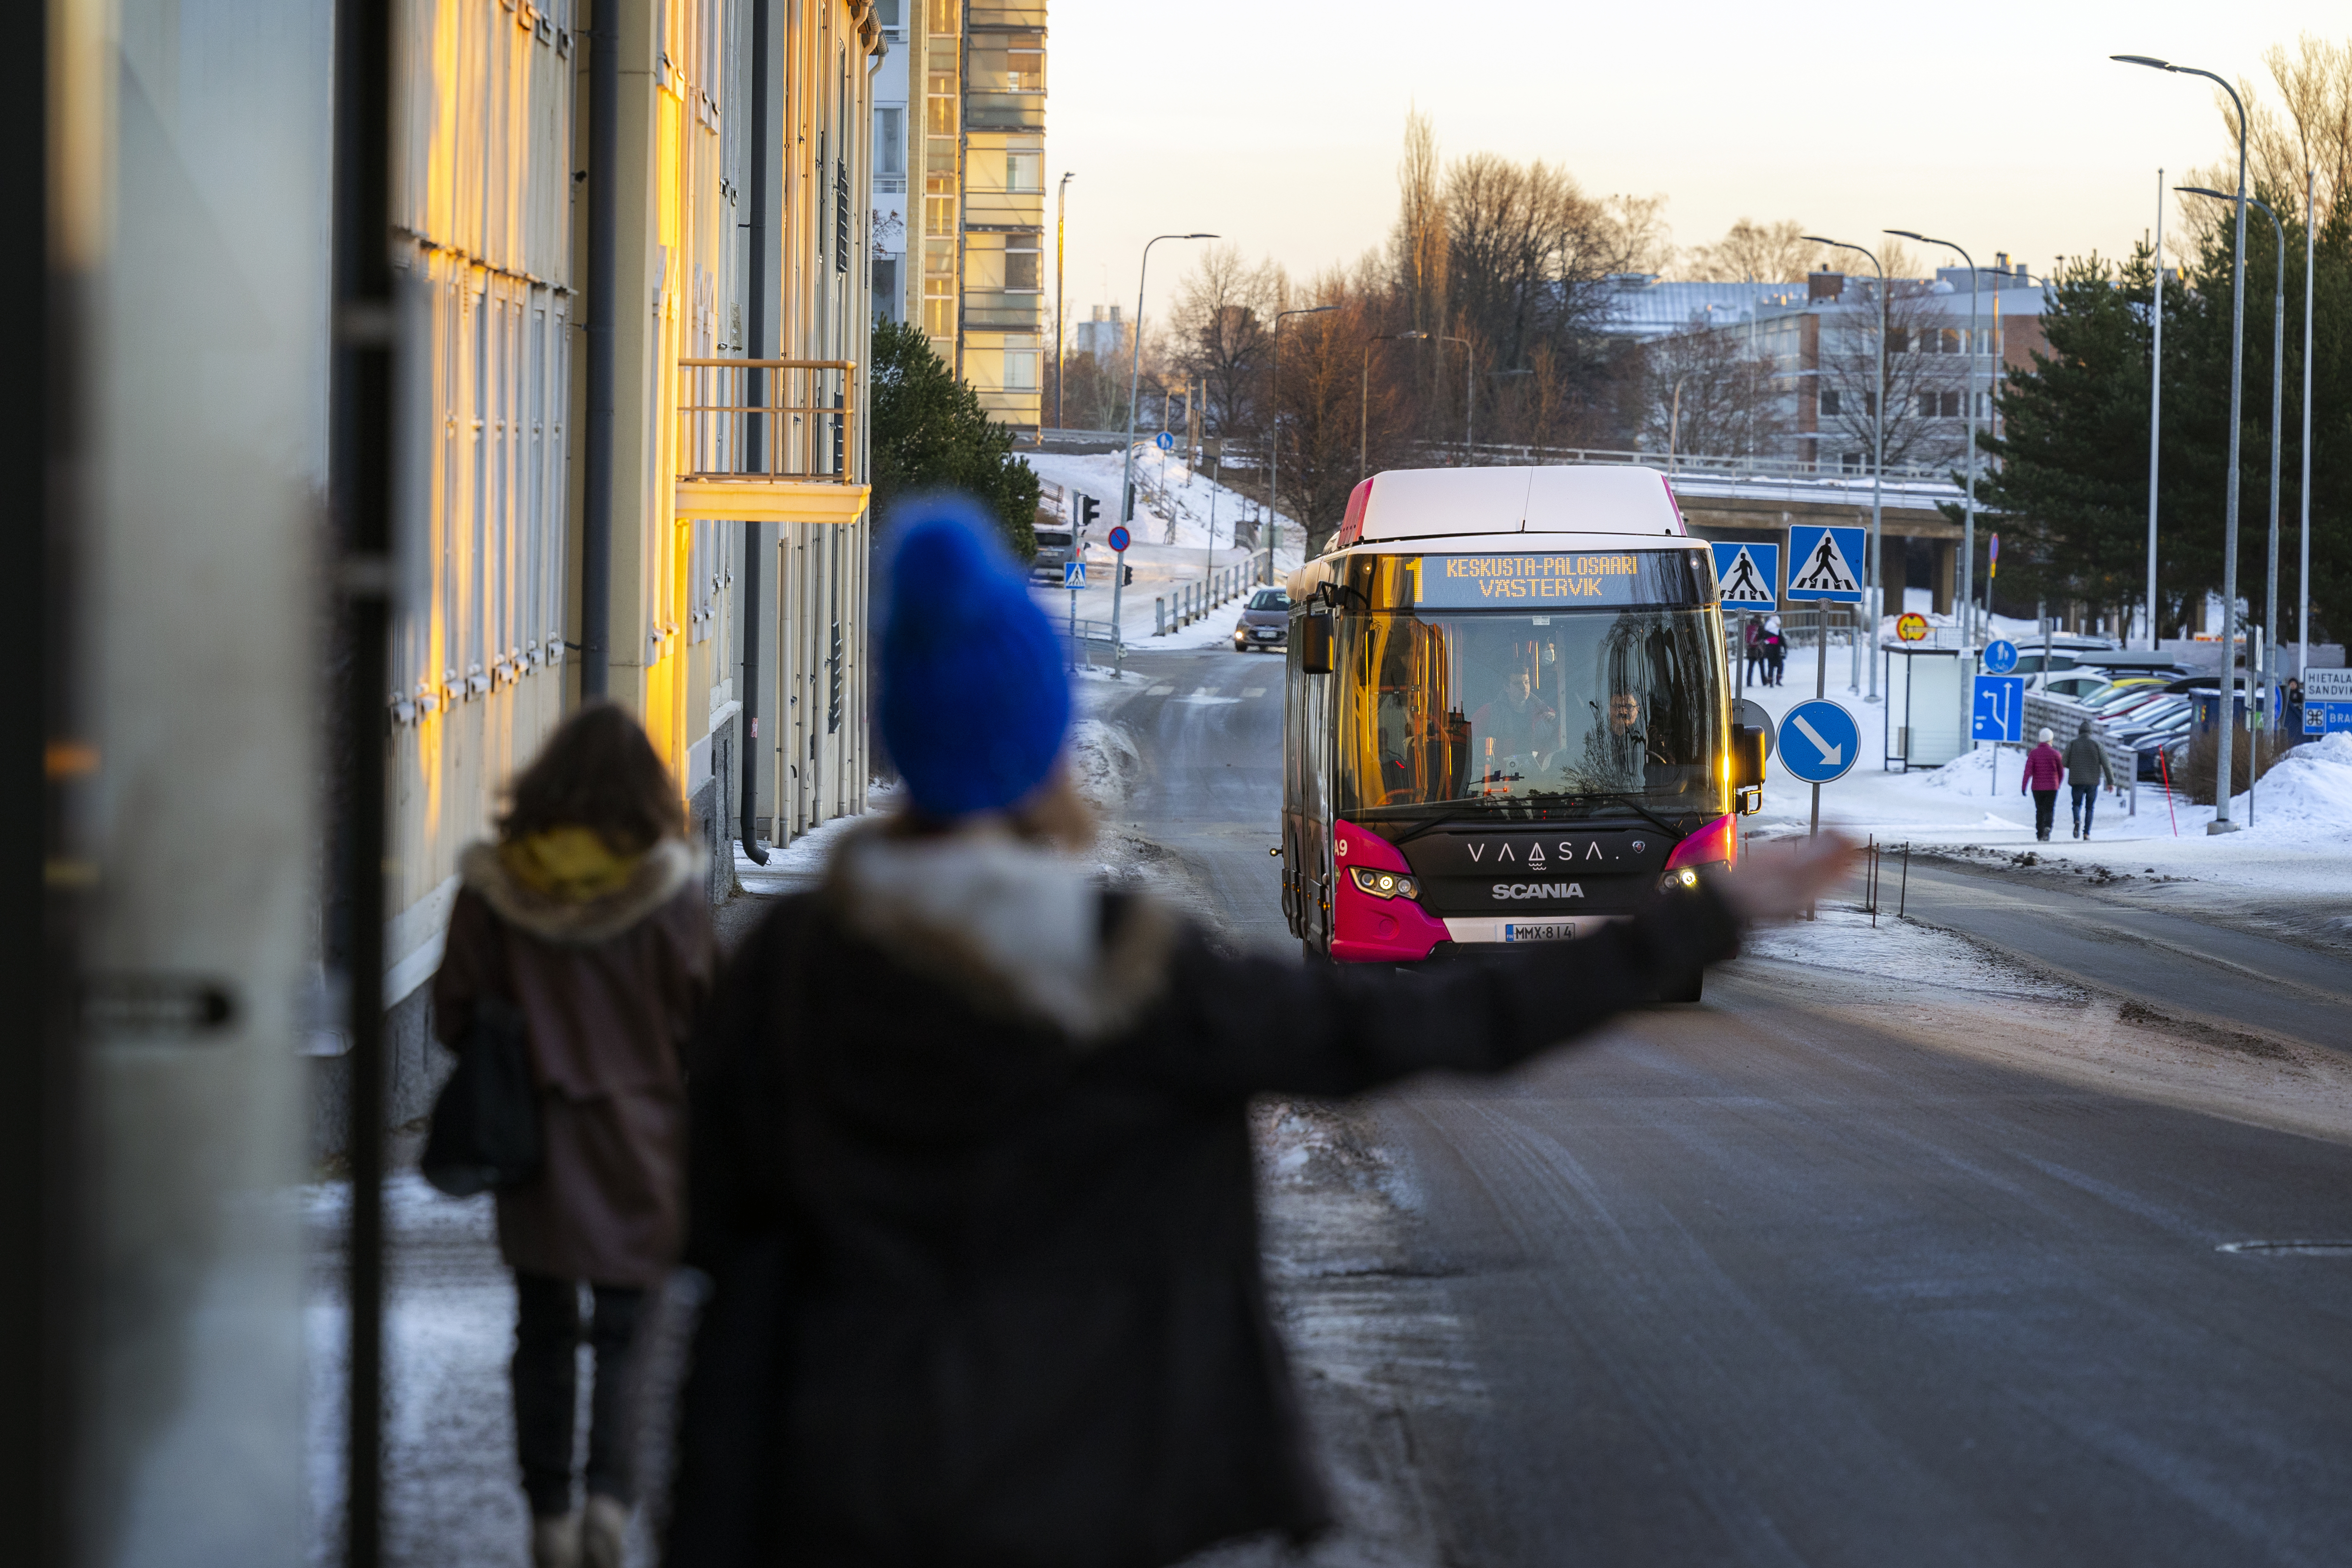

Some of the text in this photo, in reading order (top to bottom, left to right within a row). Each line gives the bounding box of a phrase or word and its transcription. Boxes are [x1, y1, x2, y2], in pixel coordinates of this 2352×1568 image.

[1446, 556, 1637, 577] KESKUSTA-PALOSAARI
[1406, 557, 1423, 603] 1
[1479, 578, 1603, 597] VÄSTERVIK
[2309, 673, 2352, 684] HIETALA
[2329, 713, 2352, 723] BRA
[1492, 883, 1585, 899] SCANIA
